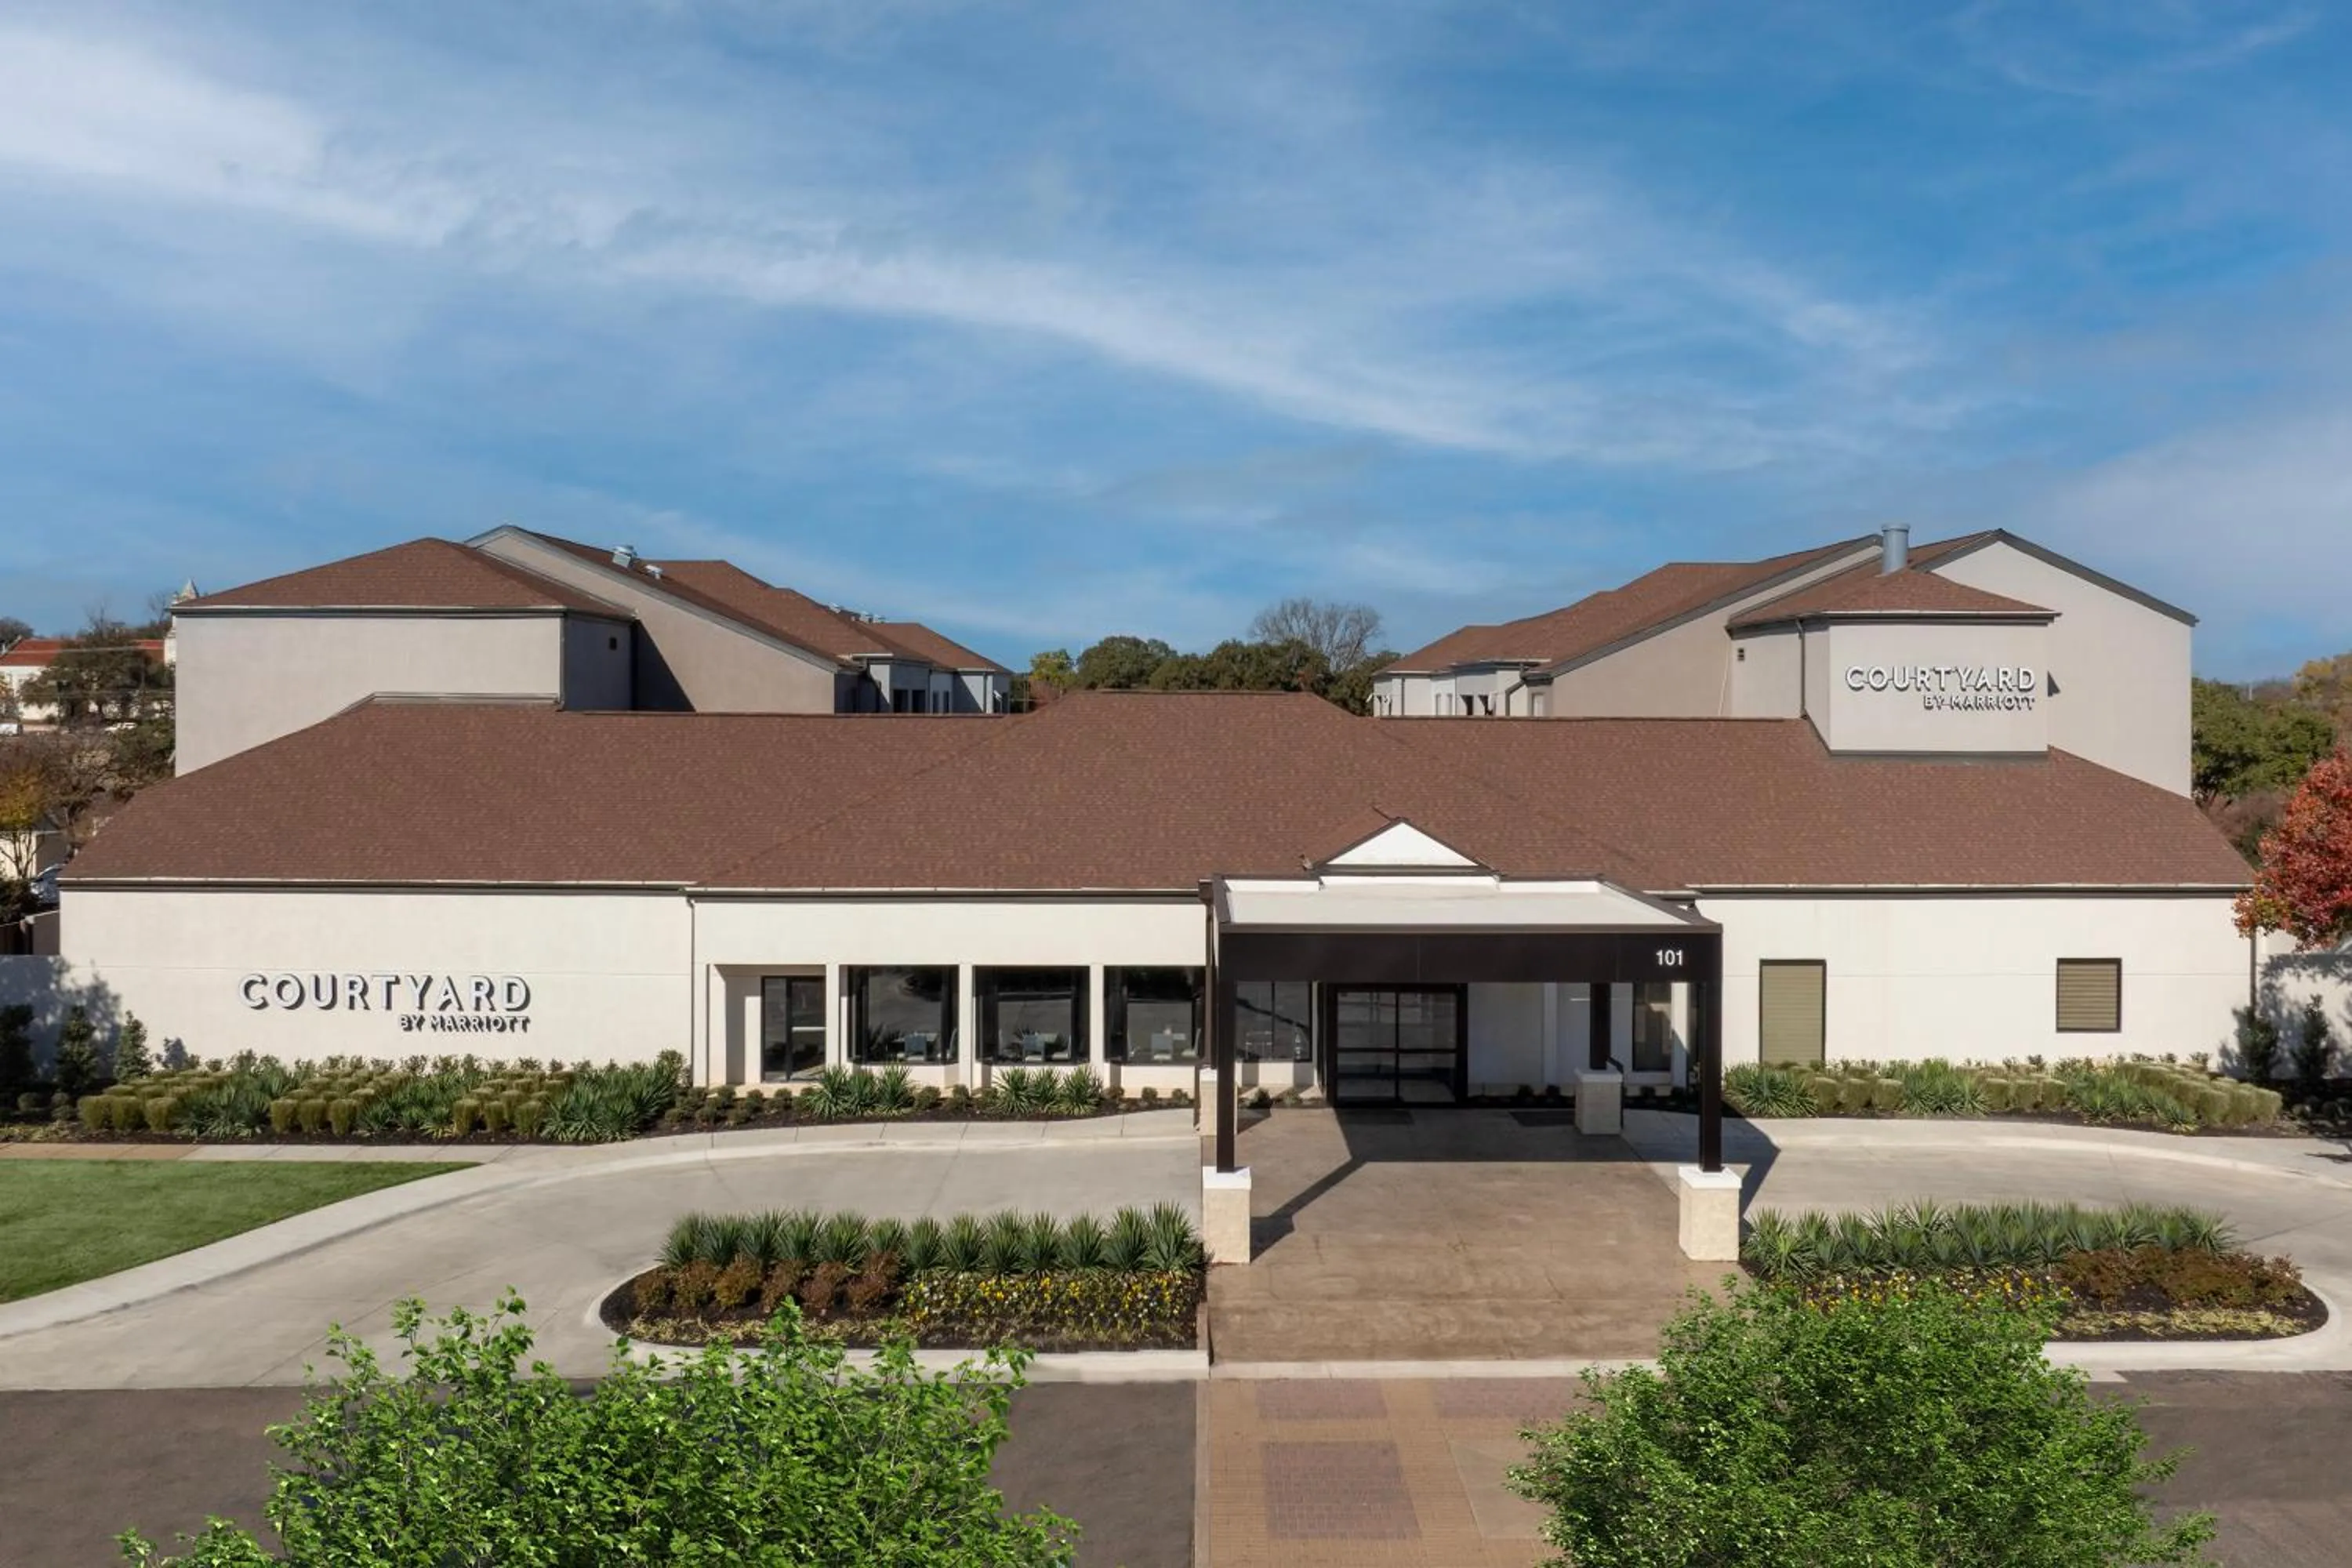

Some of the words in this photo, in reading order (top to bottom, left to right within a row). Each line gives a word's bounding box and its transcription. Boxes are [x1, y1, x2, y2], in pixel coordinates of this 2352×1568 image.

[1846, 666, 2035, 692] COURTYARD
[1923, 695, 1946, 710] BY
[1951, 695, 2035, 711] MARRIOTT
[1656, 949, 1682, 966] 101
[239, 974, 531, 1011] COURTYARD
[401, 1014, 426, 1032] BY
[430, 1015, 532, 1033] MARRIOTT
